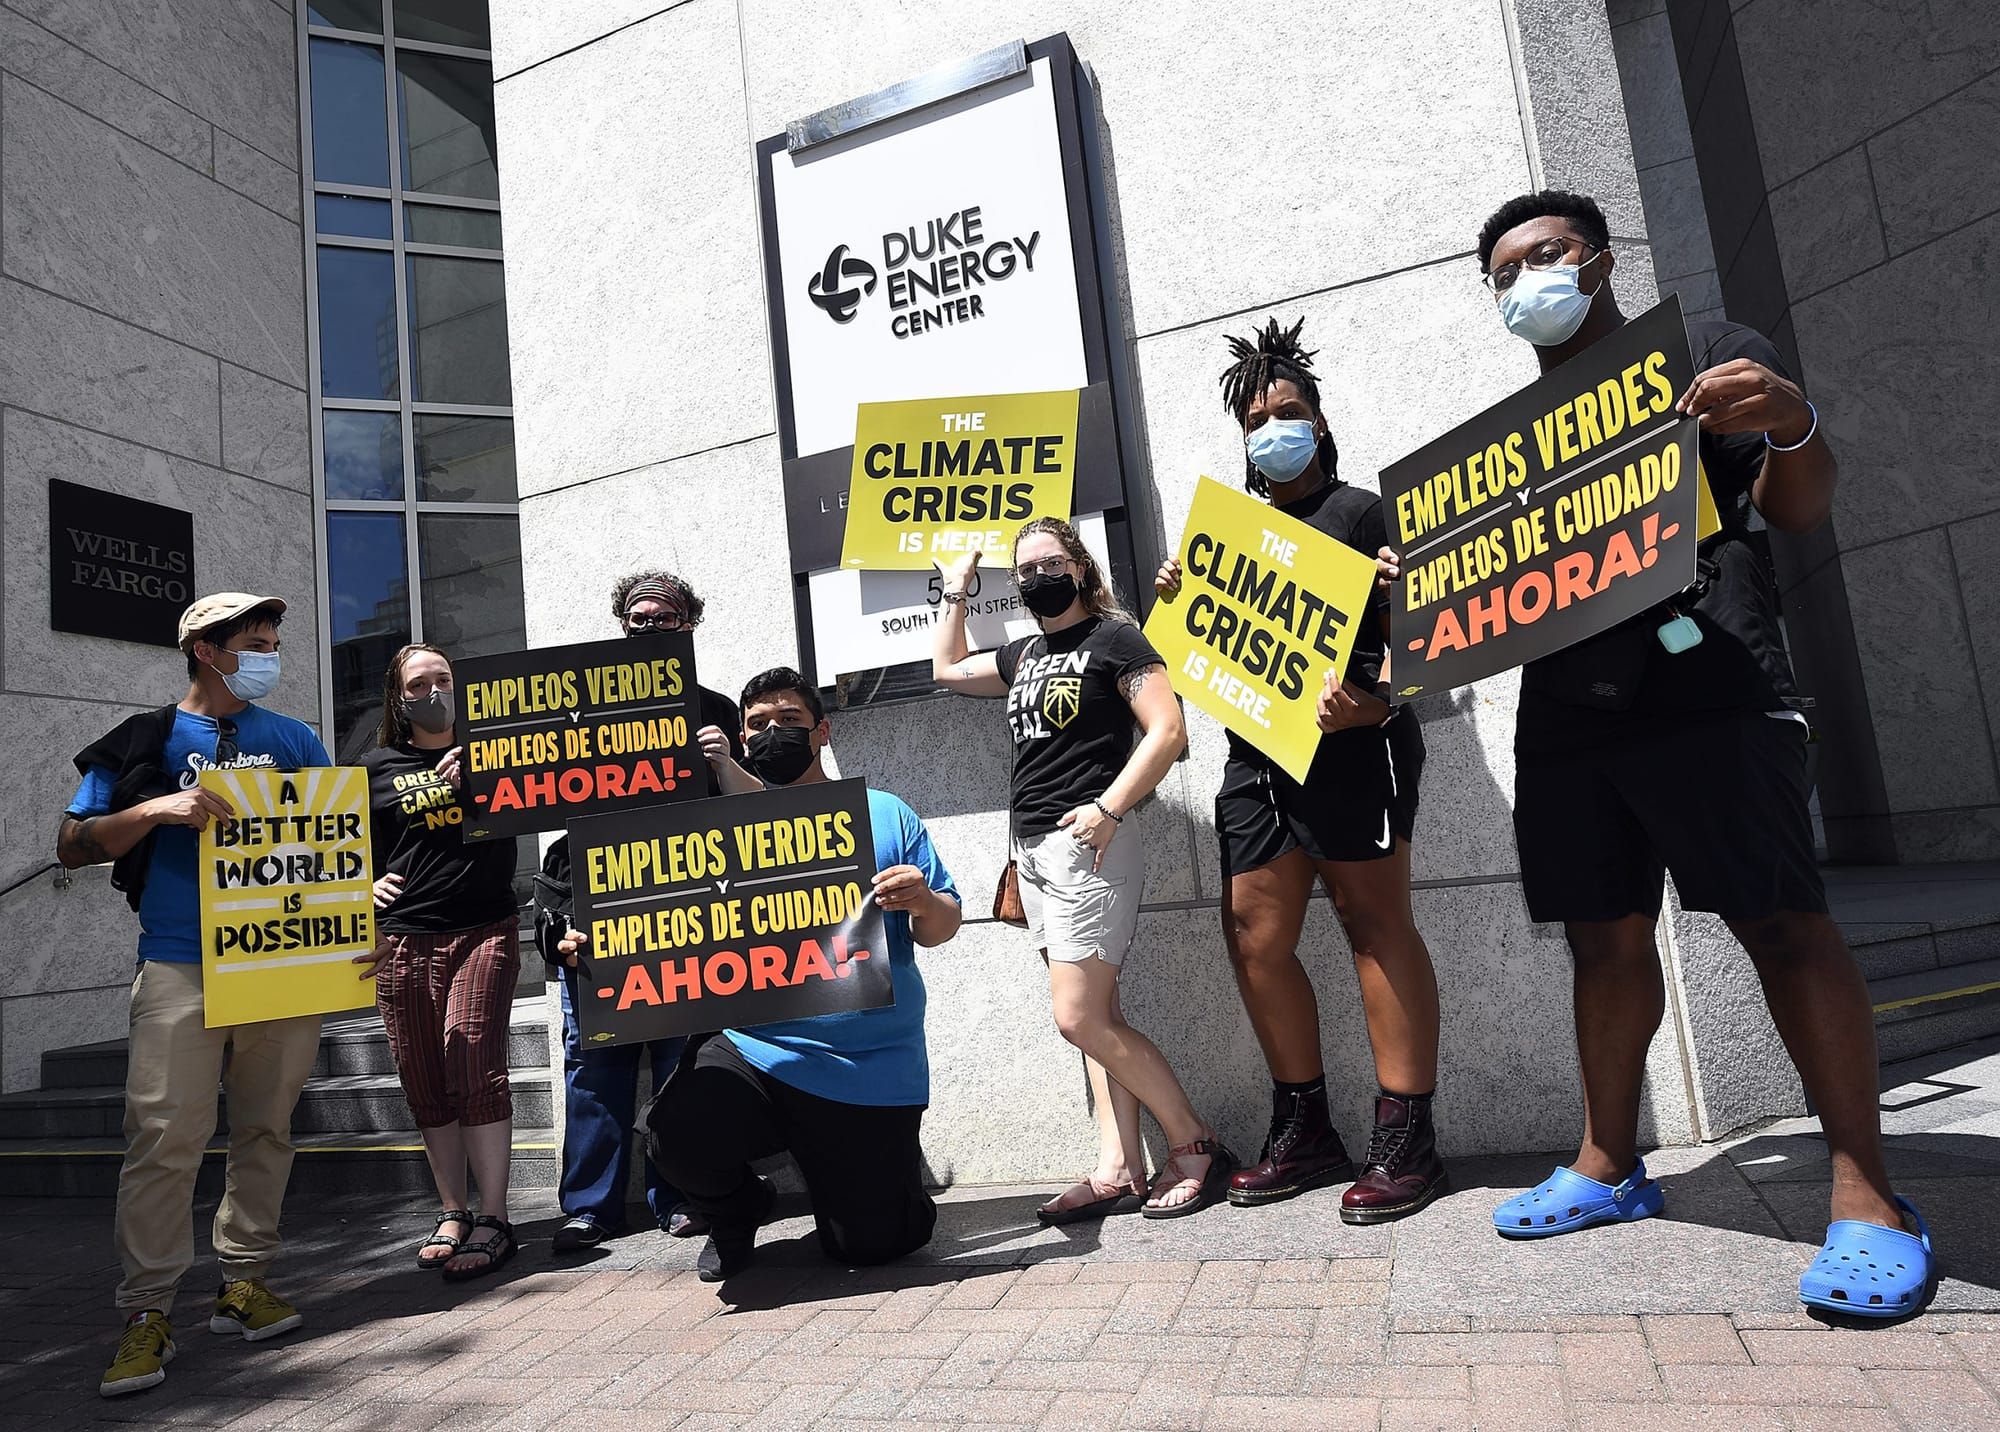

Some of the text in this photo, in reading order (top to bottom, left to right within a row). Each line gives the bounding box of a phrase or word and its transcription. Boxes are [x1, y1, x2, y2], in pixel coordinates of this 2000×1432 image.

[883, 206, 984, 271] DUKE
[887, 231, 1041, 311] ENERGY
[891, 295, 984, 339] CENTER
[941, 412, 986, 433] THE
[864, 435, 1063, 479] CLIMATE
[1396, 351, 1673, 545] EMPLEOS VERDES
[882, 483, 1034, 523] CRISIS
[1516, 487, 1531, 507] Y
[898, 530, 1007, 553] IS HERE.
[1406, 442, 1681, 612] EMPLEOS DE CUIDADO
[66, 527, 187, 573] WELLS
[1260, 528, 1298, 568] THE
[72, 560, 187, 603] FARGO
[926, 571, 982, 606] 50
[1187, 533, 1349, 662] CLIMATE
[881, 612, 929, 634] SOUTH
[1186, 594, 1310, 700] CRISIS
[466, 658, 684, 721] EMPLEOS VERDES
[1007, 680, 1044, 714] EW
[1182, 650, 1272, 729] IS HERE.
[569, 711, 581, 723] Y
[1009, 711, 1051, 744] EAL
[469, 716, 688, 773] EMPLEOS DE CUIDADO
[280, 780, 299, 805] A
[393, 770, 439, 791] GREE
[401, 785, 455, 814] CARE
[215, 813, 361, 847] BETTER
[215, 851, 363, 889] WORLD
[586, 810, 856, 895] EMPLEOS VERDES
[284, 893, 301, 914] IS
[716, 880, 729, 894] Y
[215, 913, 367, 957] POSSIBLE
[591, 881, 863, 959] EMPLEOS DE CUIDADO
